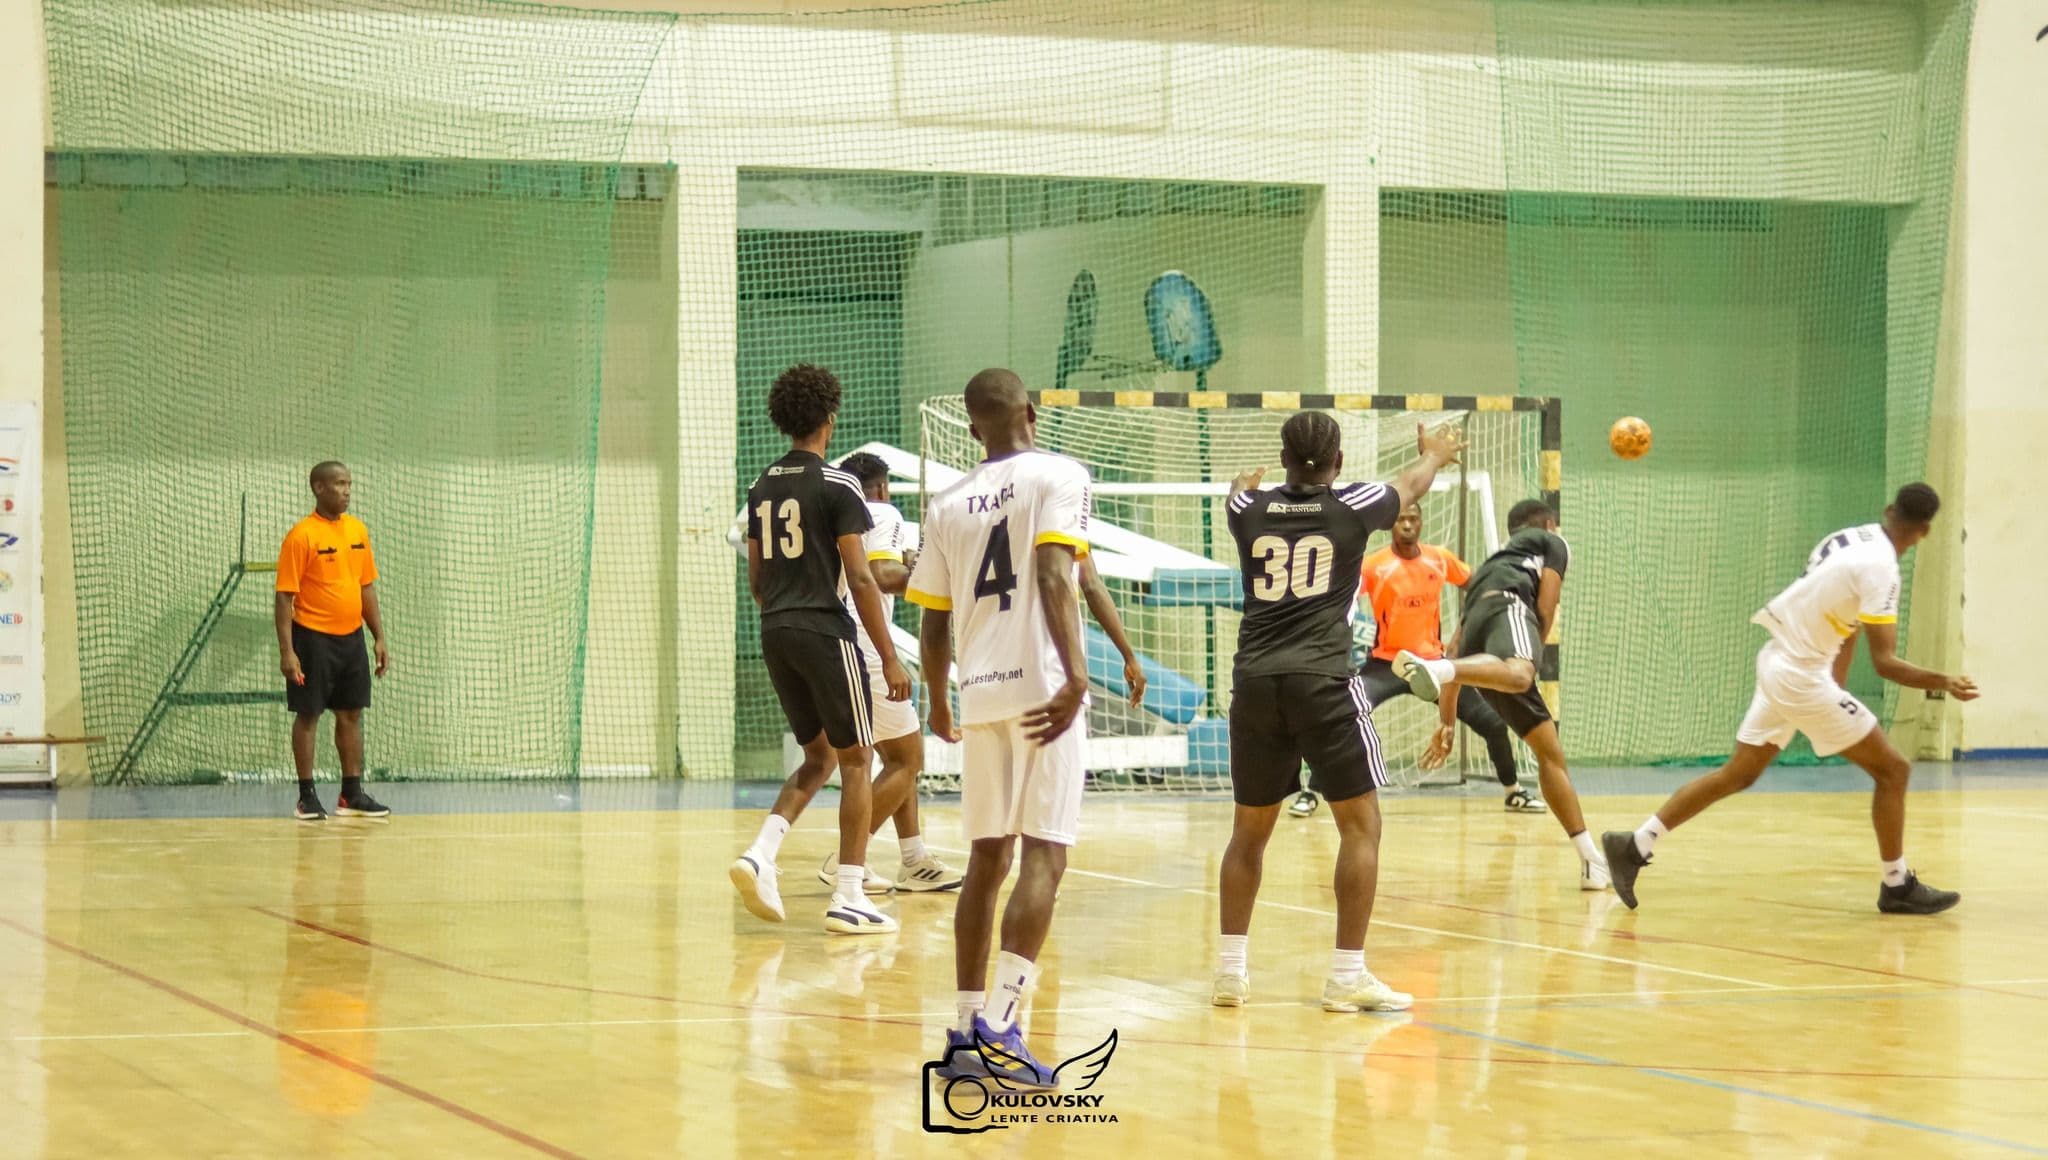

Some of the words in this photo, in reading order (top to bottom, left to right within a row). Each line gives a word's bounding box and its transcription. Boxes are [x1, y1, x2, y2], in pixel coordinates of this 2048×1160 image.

[755, 498, 804, 560] 13
[974, 515, 1017, 613] 4
[1252, 535, 1334, 602] 30
[1838, 700, 1858, 715] 5
